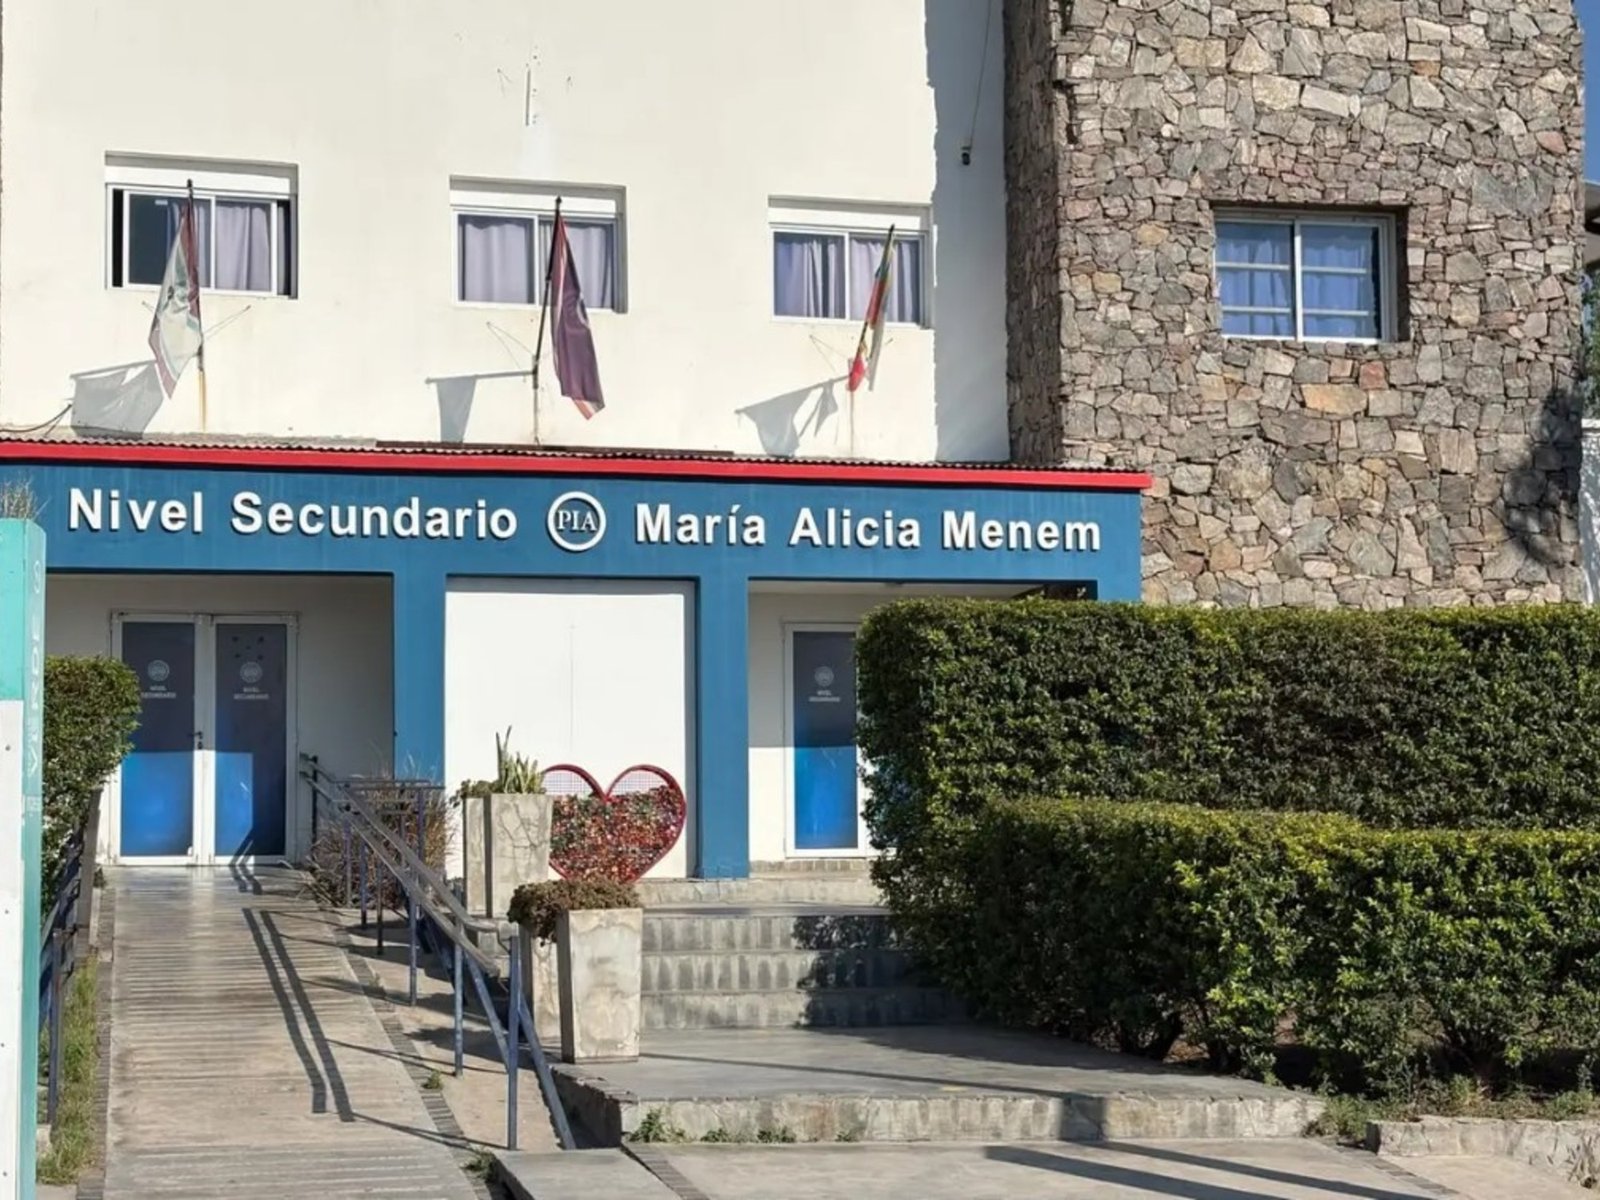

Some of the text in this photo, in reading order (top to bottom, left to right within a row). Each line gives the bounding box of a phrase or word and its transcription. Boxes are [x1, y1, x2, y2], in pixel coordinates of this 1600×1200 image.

[71, 489, 1100, 549] Nivel Secundario PIA María Alicia Menem
